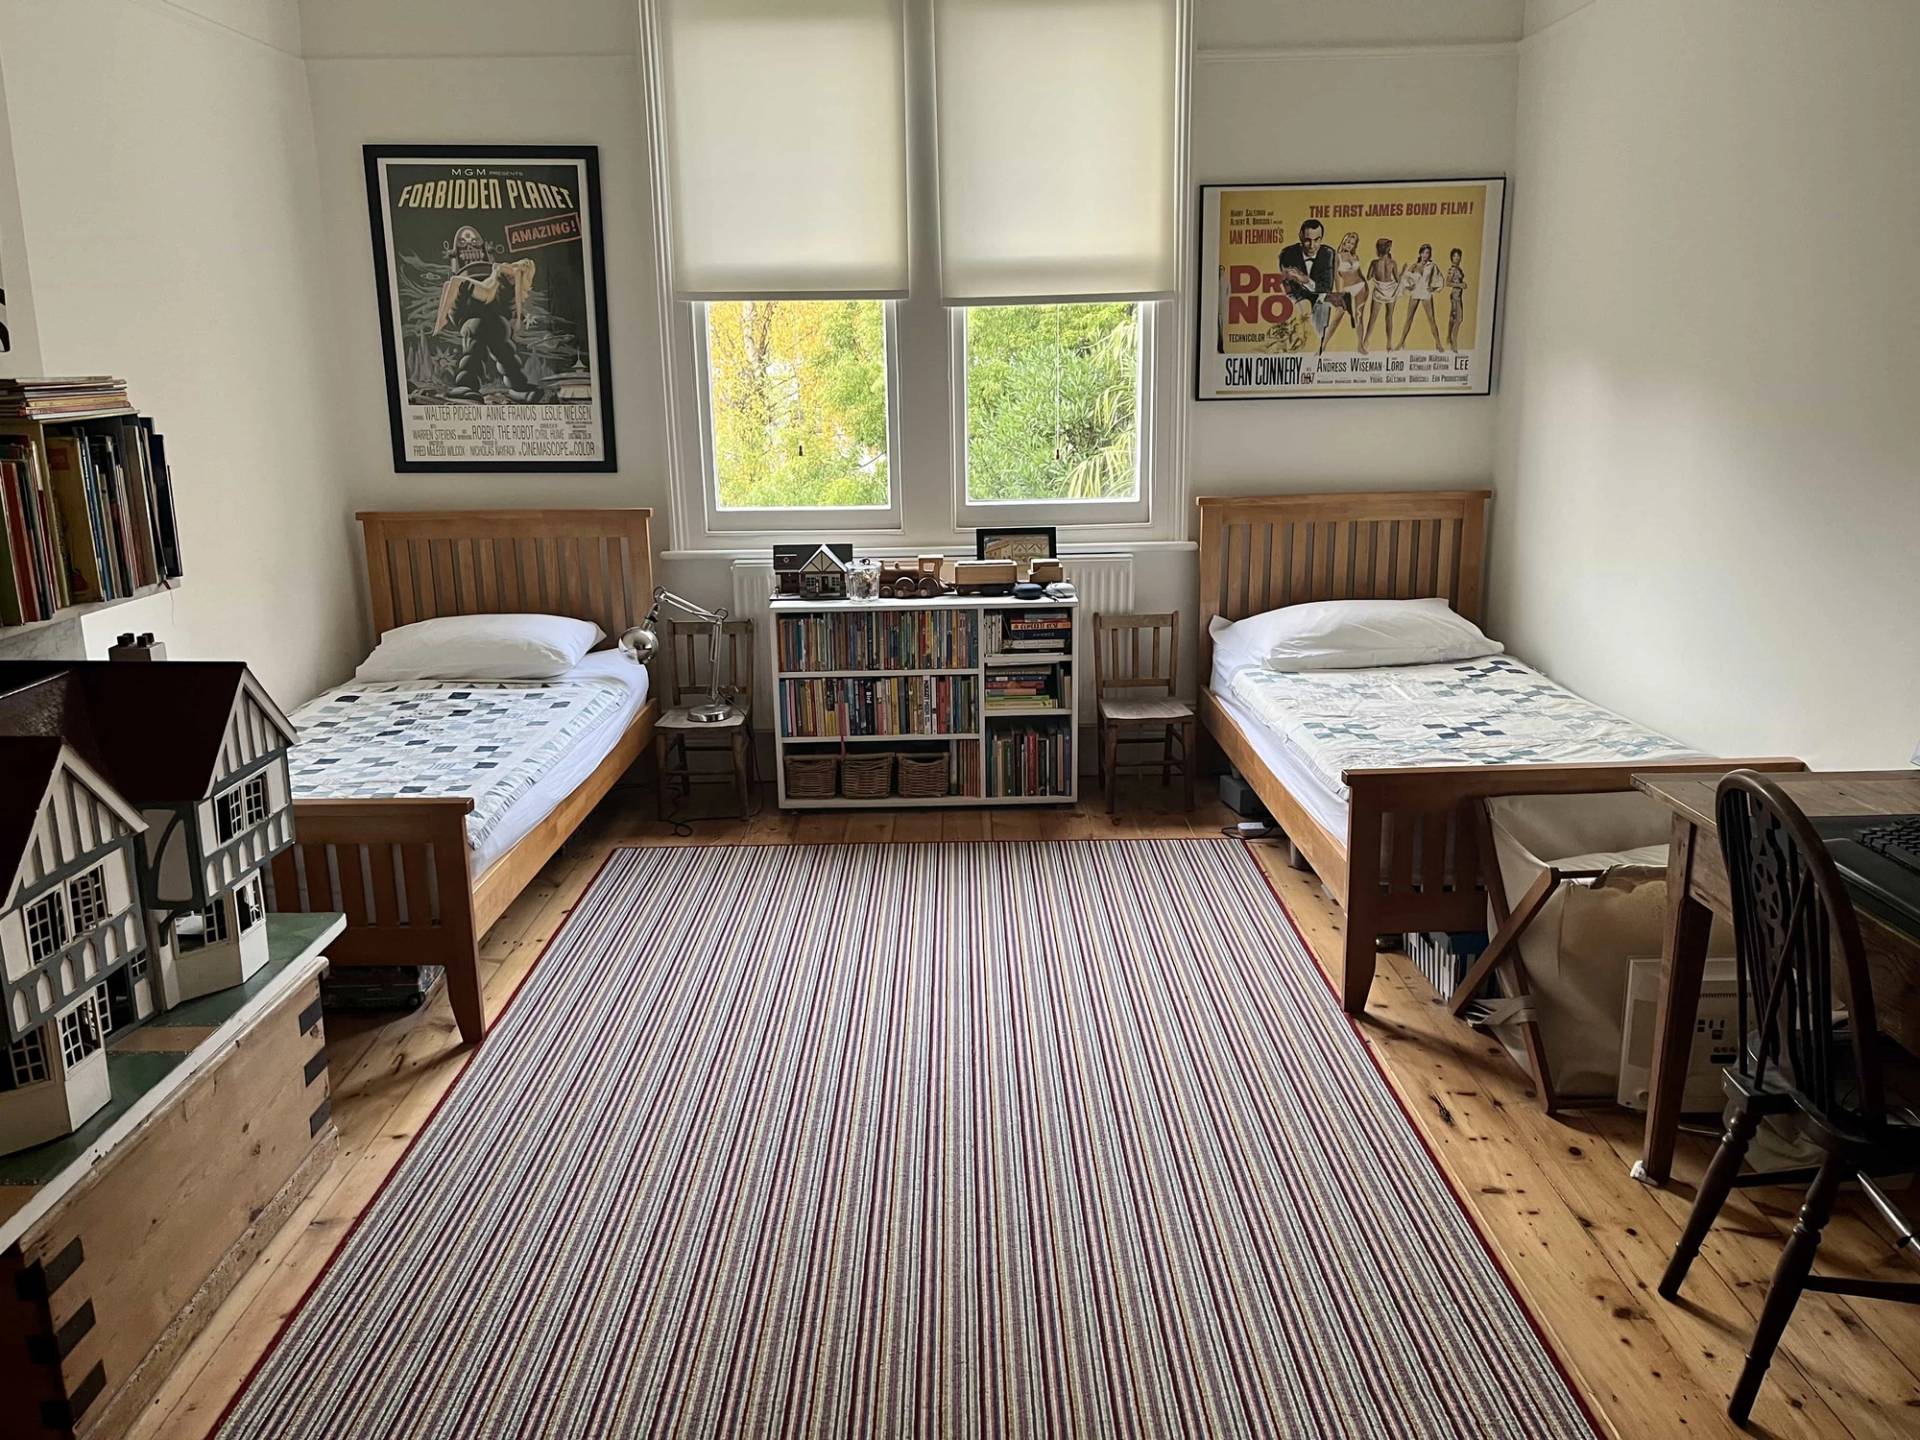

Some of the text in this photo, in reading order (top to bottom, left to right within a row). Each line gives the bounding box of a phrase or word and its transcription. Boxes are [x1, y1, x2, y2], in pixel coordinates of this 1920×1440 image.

[398, 179, 574, 209] FORBIDDEN PLANET
[1310, 202, 1474, 218] THE FIRST JAMES BOND FILM!
[511, 220, 576, 244] AMAZING!
[1230, 227, 1284, 244] IAN FLEMING'S
[1228, 294, 1294, 324] NO
[1228, 334, 1266, 342] TECHNICOLOR
[1316, 357, 1404, 372] ANDRESS WISEMAN LORD
[1454, 356, 1470, 370] LEE
[1226, 356, 1303, 386] SEAN CONNERY
[424, 406, 482, 421] WALTER PIDGEON
[486, 406, 536, 421] ANNE FRANCIS
[541, 406, 592, 420] LESLIE NIELSEN
[498, 425, 511, 440] THE
[512, 425, 534, 440] ROBOT
[521, 442, 569, 456] CINEMASCOPE
[574, 442, 595, 456] COLOR
